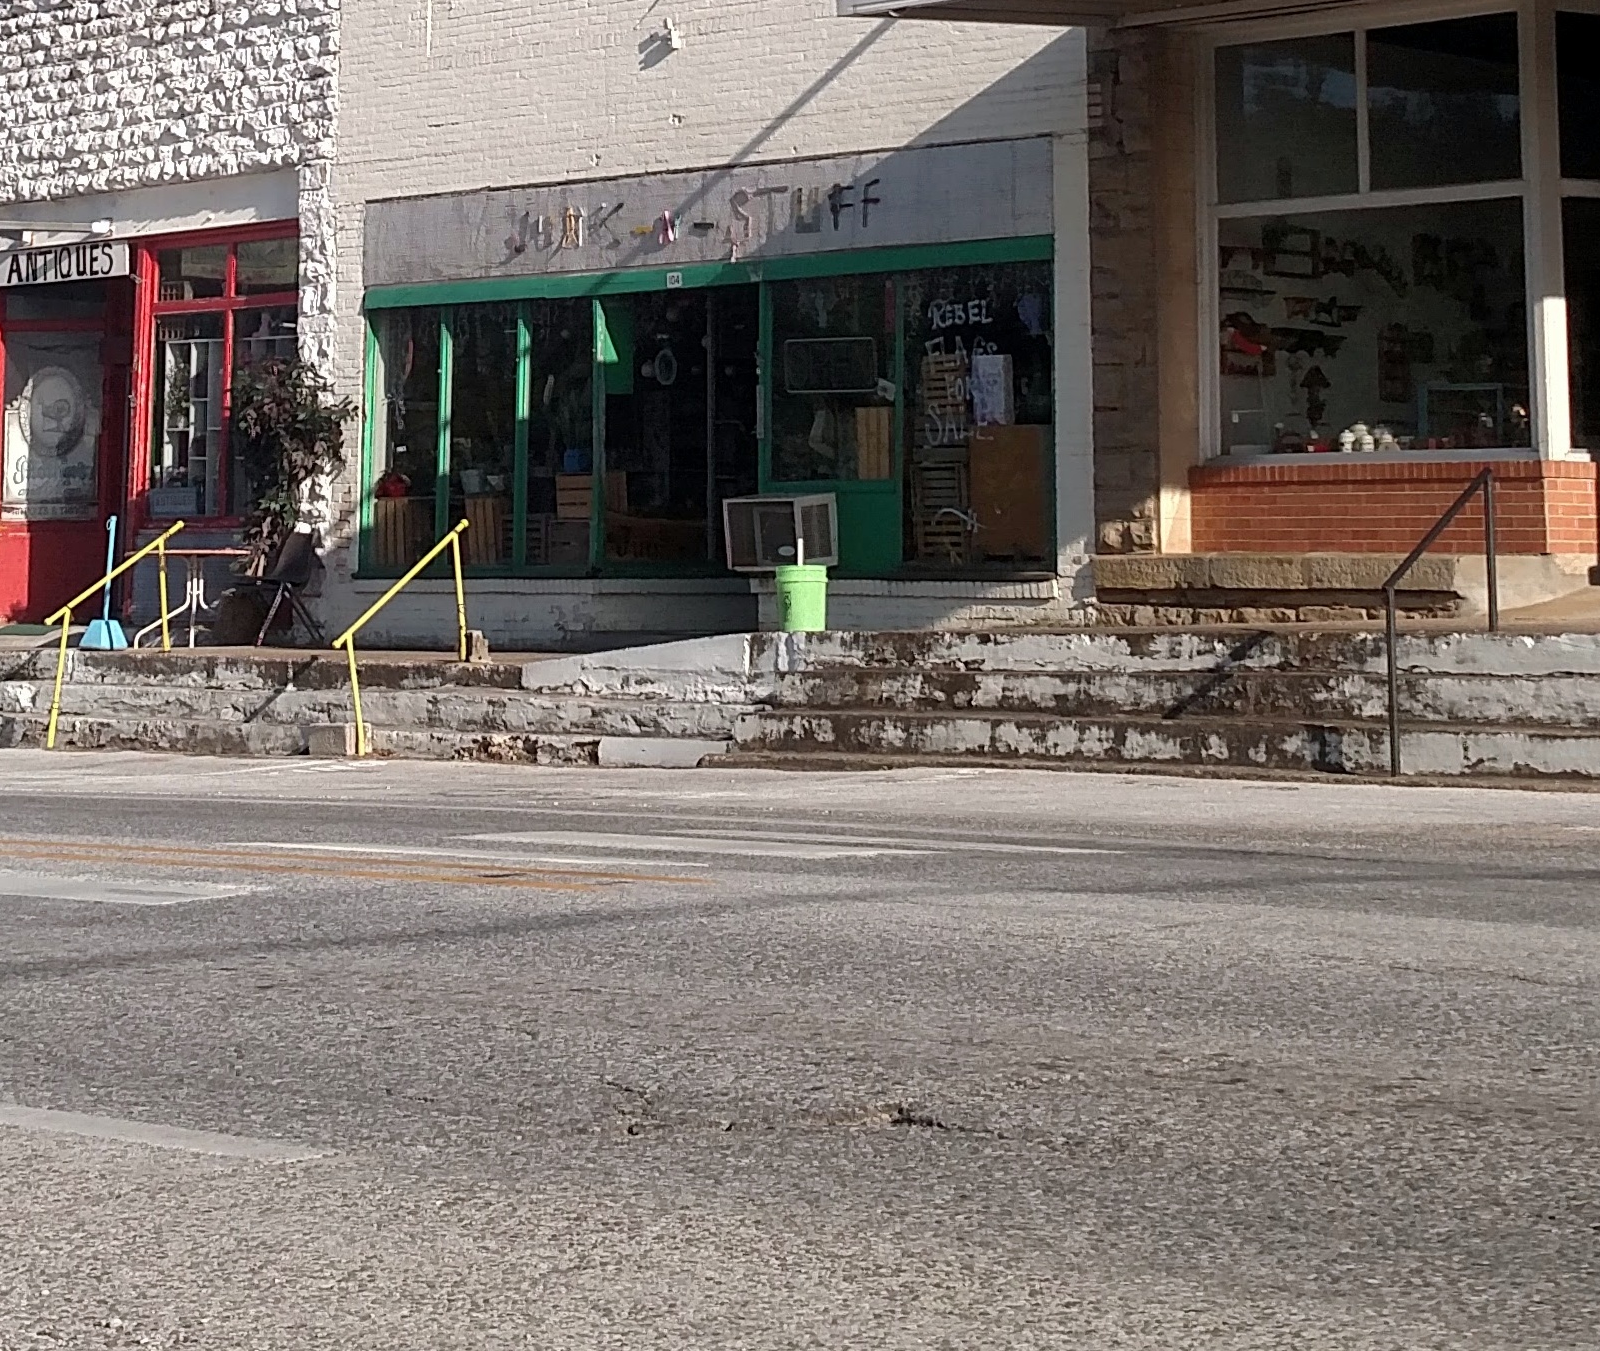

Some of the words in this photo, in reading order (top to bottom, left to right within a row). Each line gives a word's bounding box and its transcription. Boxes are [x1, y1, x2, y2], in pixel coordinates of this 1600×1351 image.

[730, 179, 881, 254] STUFF
[7, 242, 114, 284] ANTIQUES
[668, 274, 681, 286] 104
[927, 299, 994, 331] REBEL
